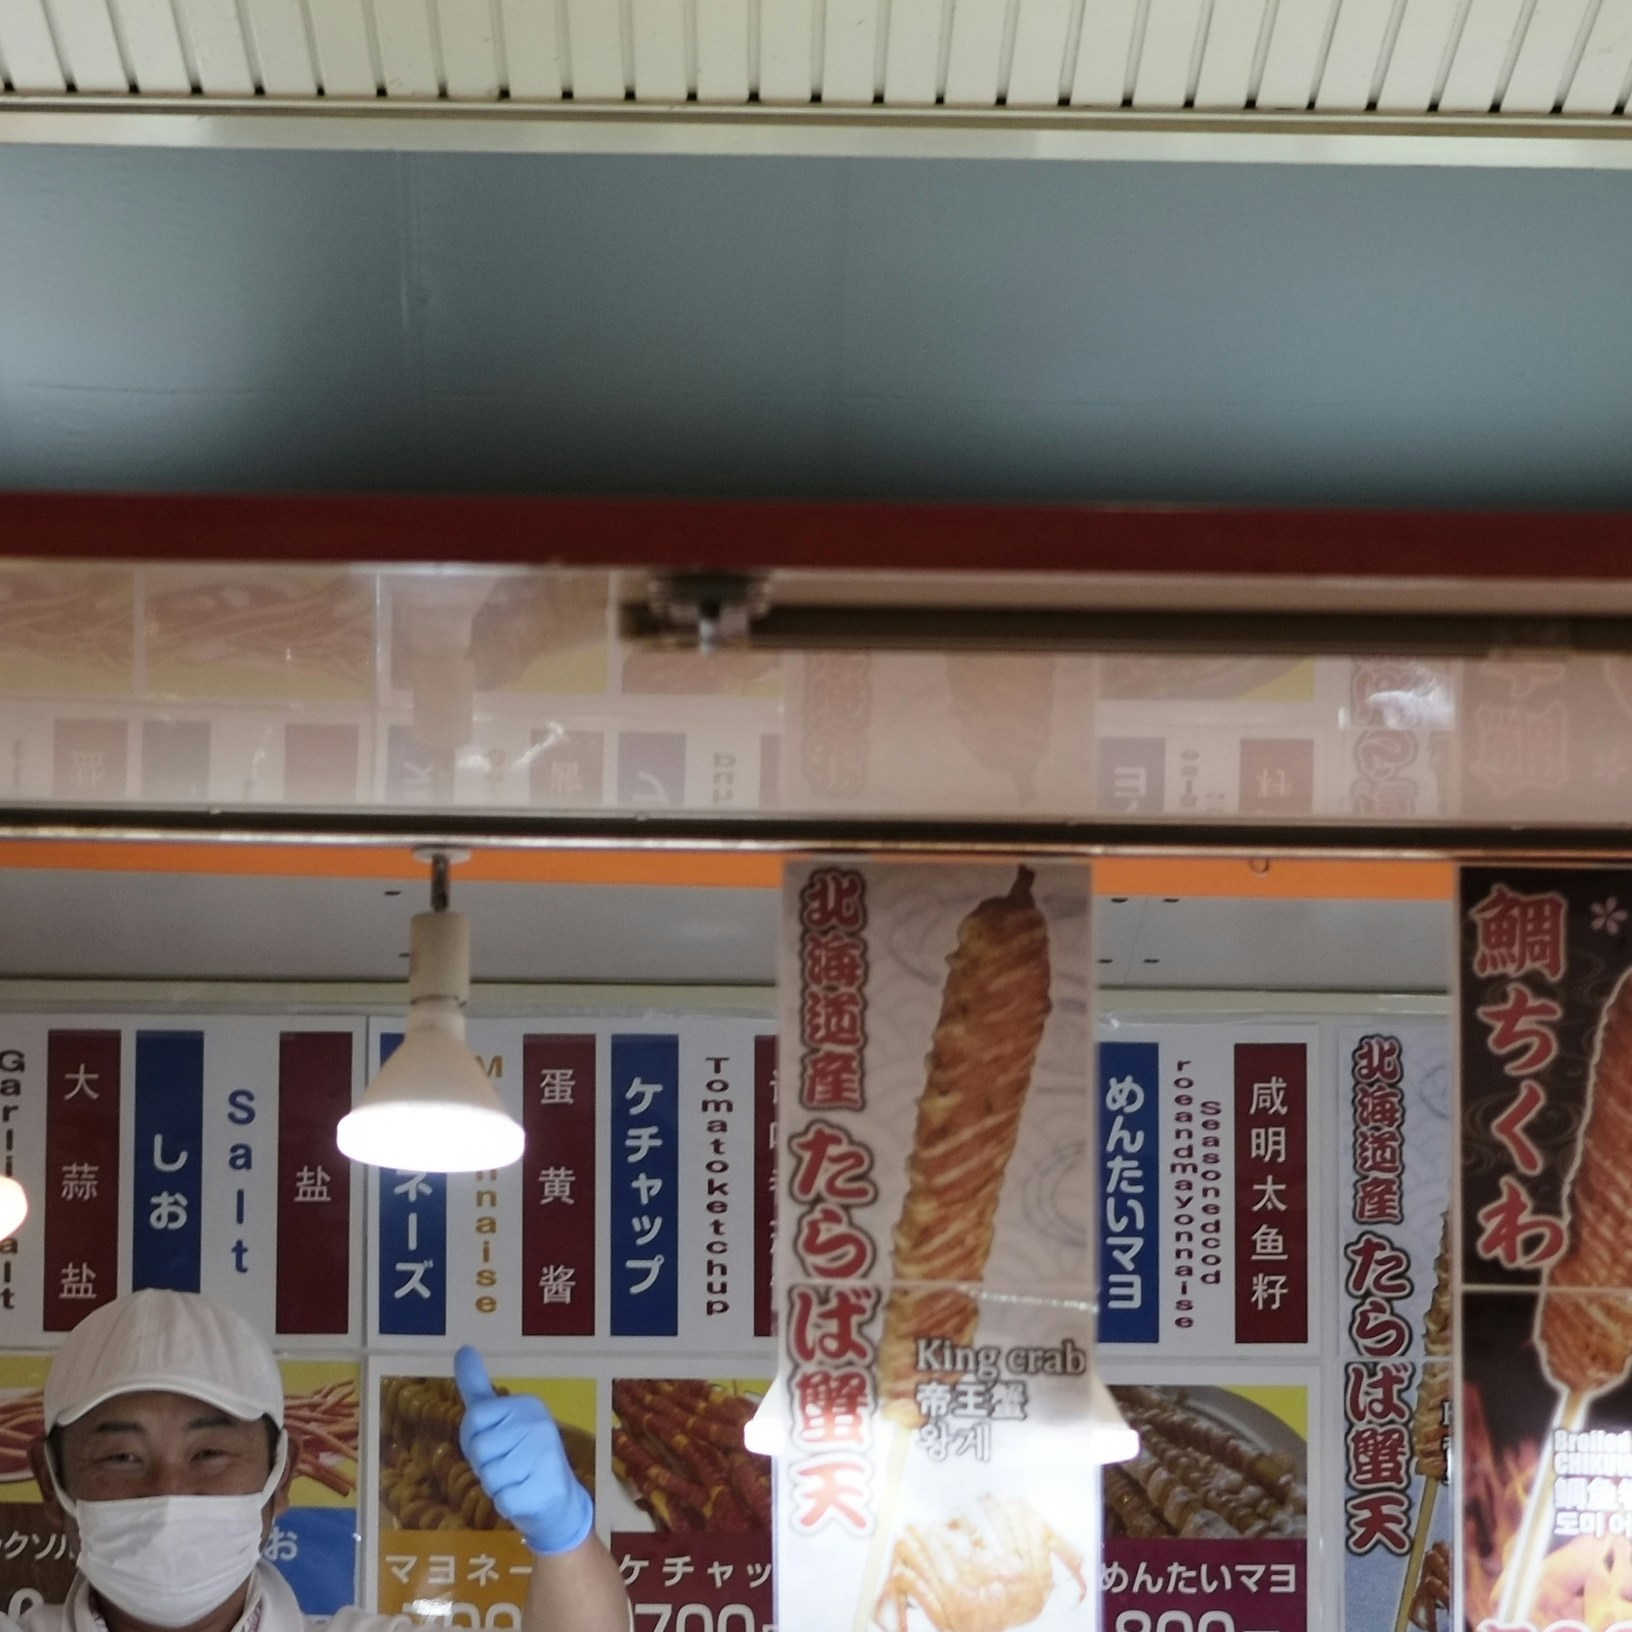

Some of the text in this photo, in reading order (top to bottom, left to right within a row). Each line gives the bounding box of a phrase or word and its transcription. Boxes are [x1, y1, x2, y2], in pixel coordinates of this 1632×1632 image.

[1470, 884, 1569, 1271] 鯛ちくわ
[59, 1063, 100, 1300] 大蒜盐
[148, 1133, 189, 1231] しお
[227, 1089, 257, 1274] Salt
[293, 1165, 332, 1203] 盐
[624, 1076, 664, 1295] ケチャップ
[1104, 1073, 1146, 1310] めんたいマヨ
[393, 1170, 435, 1300] ネーズ
[916, 1336, 1088, 1385] King crab
[264, 1525, 299, 1562] お
[384, 1553, 534, 1588] マヨネー
[618, 1554, 773, 1589] ケチャッ
[1101, 1561, 1297, 1595] めんたいマヨ
